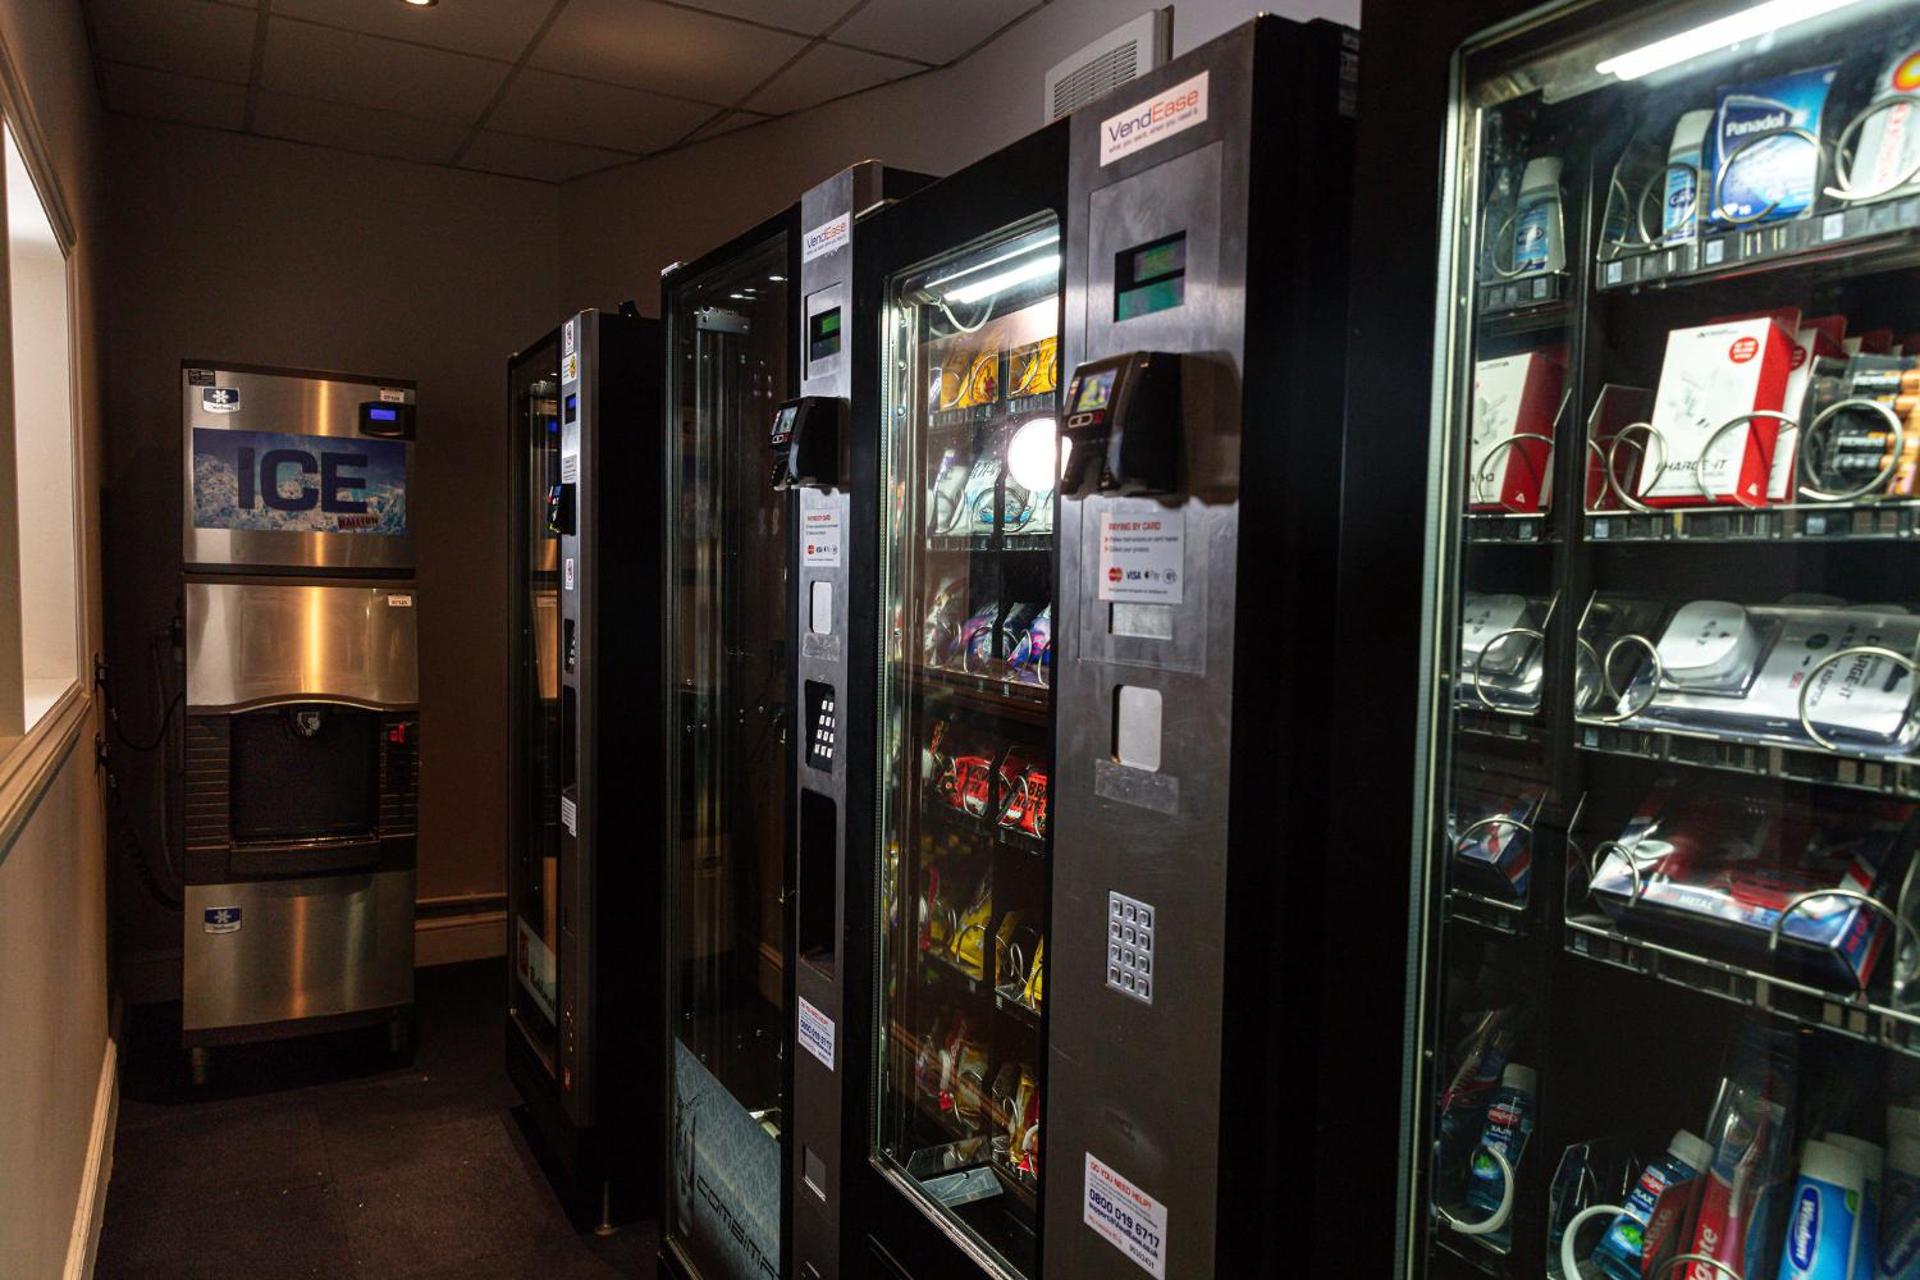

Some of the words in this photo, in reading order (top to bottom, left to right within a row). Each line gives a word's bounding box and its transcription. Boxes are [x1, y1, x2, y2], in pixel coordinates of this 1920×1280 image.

[1108, 88, 1200, 142] VendEase
[1725, 111, 1787, 137] Panadol
[237, 446, 369, 514] ICE
[1088, 1188, 1113, 1214] 0800
[1114, 1206, 1134, 1230] 019
[1135, 1222, 1161, 1249] 6717
